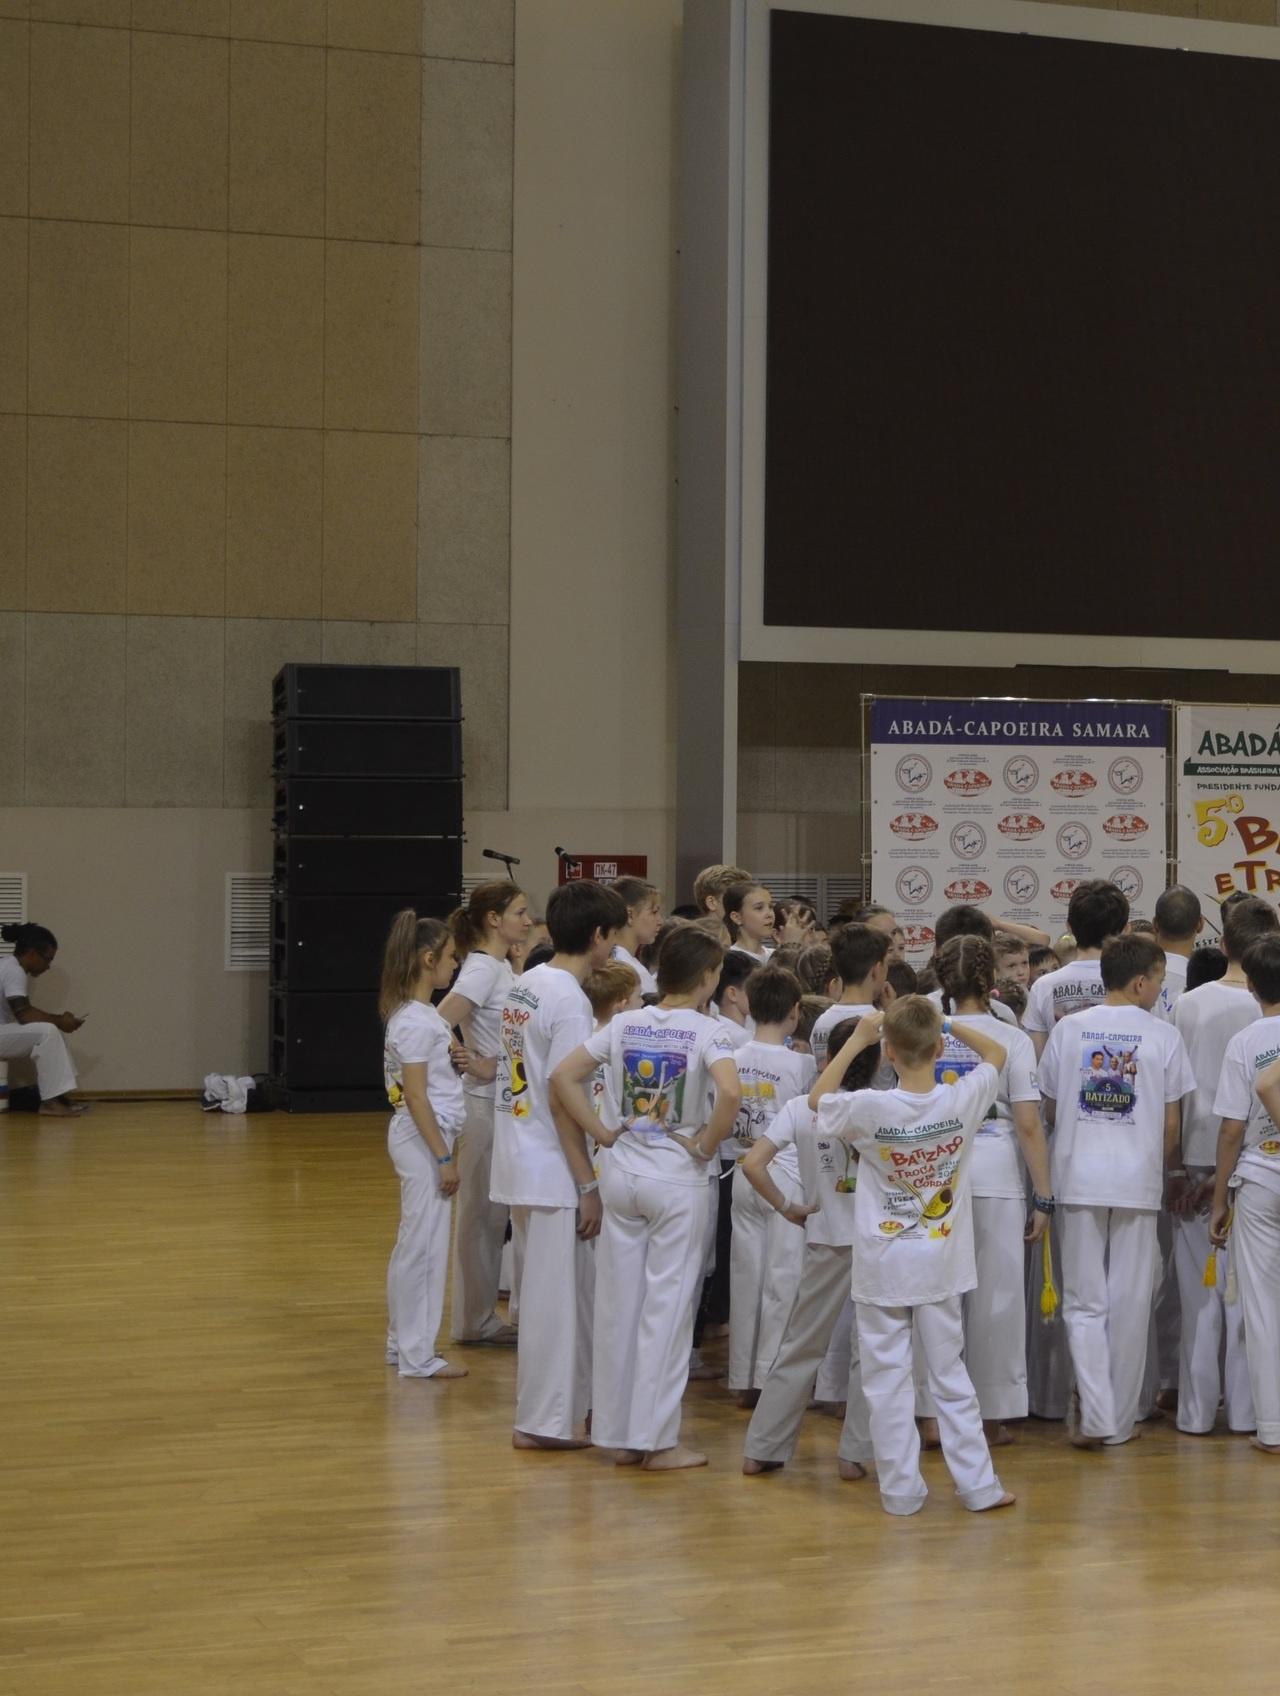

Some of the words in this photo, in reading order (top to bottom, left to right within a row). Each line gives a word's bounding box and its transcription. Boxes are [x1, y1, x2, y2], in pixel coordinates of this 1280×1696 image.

[888, 715, 1063, 738] ABADÁ-CAPOEIRA
[1072, 722, 1150, 738] SAMARA
[1196, 765, 1239, 775] ASSOCIAÇÃO
[1240, 767, 1278, 775] BRASILEIRA
[1197, 782, 1252, 792] PRESIDENTE
[595, 863, 616, 877] ПК-47
[1214, 872, 1237, 896] E
[1105, 1083, 1112, 1092] 5
[1085, 1092, 1131, 1104] BATIZADO
[876, 1117, 960, 1136] ABADÁ-CAPOEIRA
[890, 1136, 963, 1167] BATIZADO
[888, 1174, 896, 1183] E
[895, 1165, 936, 1179] TROCA
[913, 1177, 953, 1189] CORDAS
